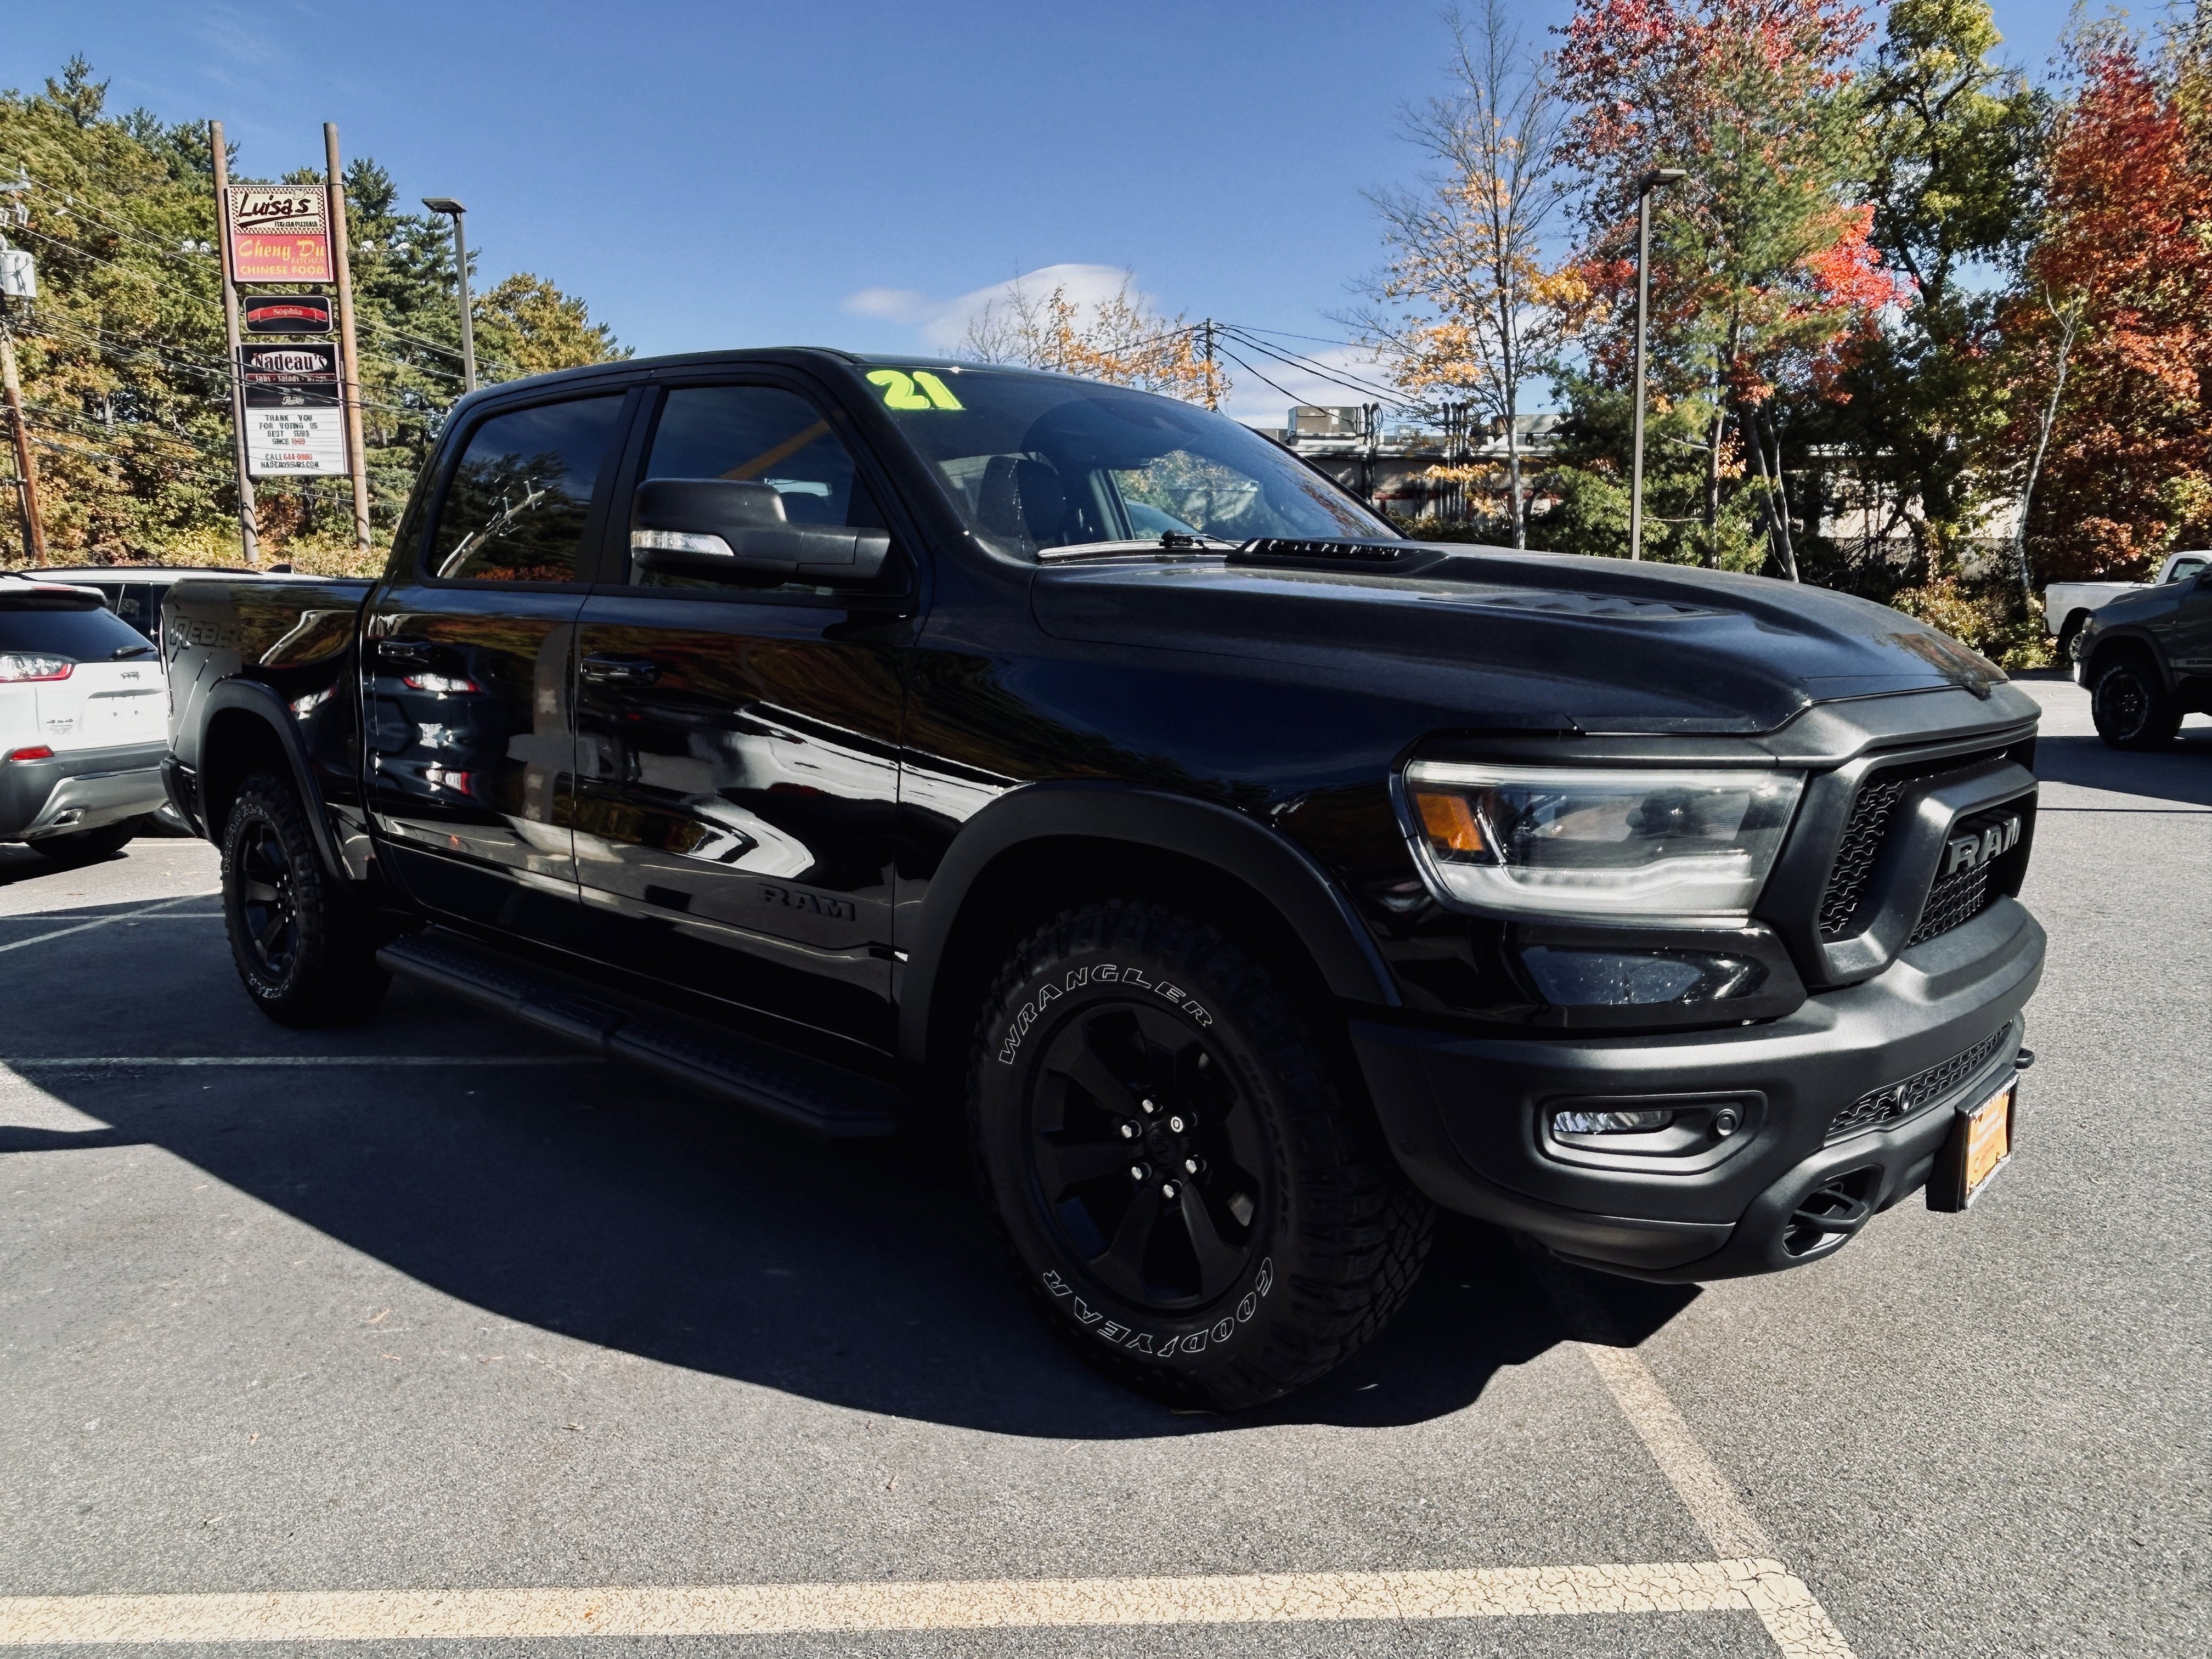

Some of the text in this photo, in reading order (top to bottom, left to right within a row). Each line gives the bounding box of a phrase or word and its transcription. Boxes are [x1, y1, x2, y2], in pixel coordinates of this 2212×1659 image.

[239, 193, 311, 217] Luisa's
[238, 239, 326, 261] Cheng Du
[240, 266, 325, 275] CHINESE FOOD
[253, 353, 327, 370] Nadeau's
[866, 370, 964, 409] 21
[1948, 815, 2021, 873] RAM
[758, 883, 856, 922] RAM
[998, 964, 1212, 1064] WRANGLER
[1042, 1257, 1273, 1357] GOODYEAR
